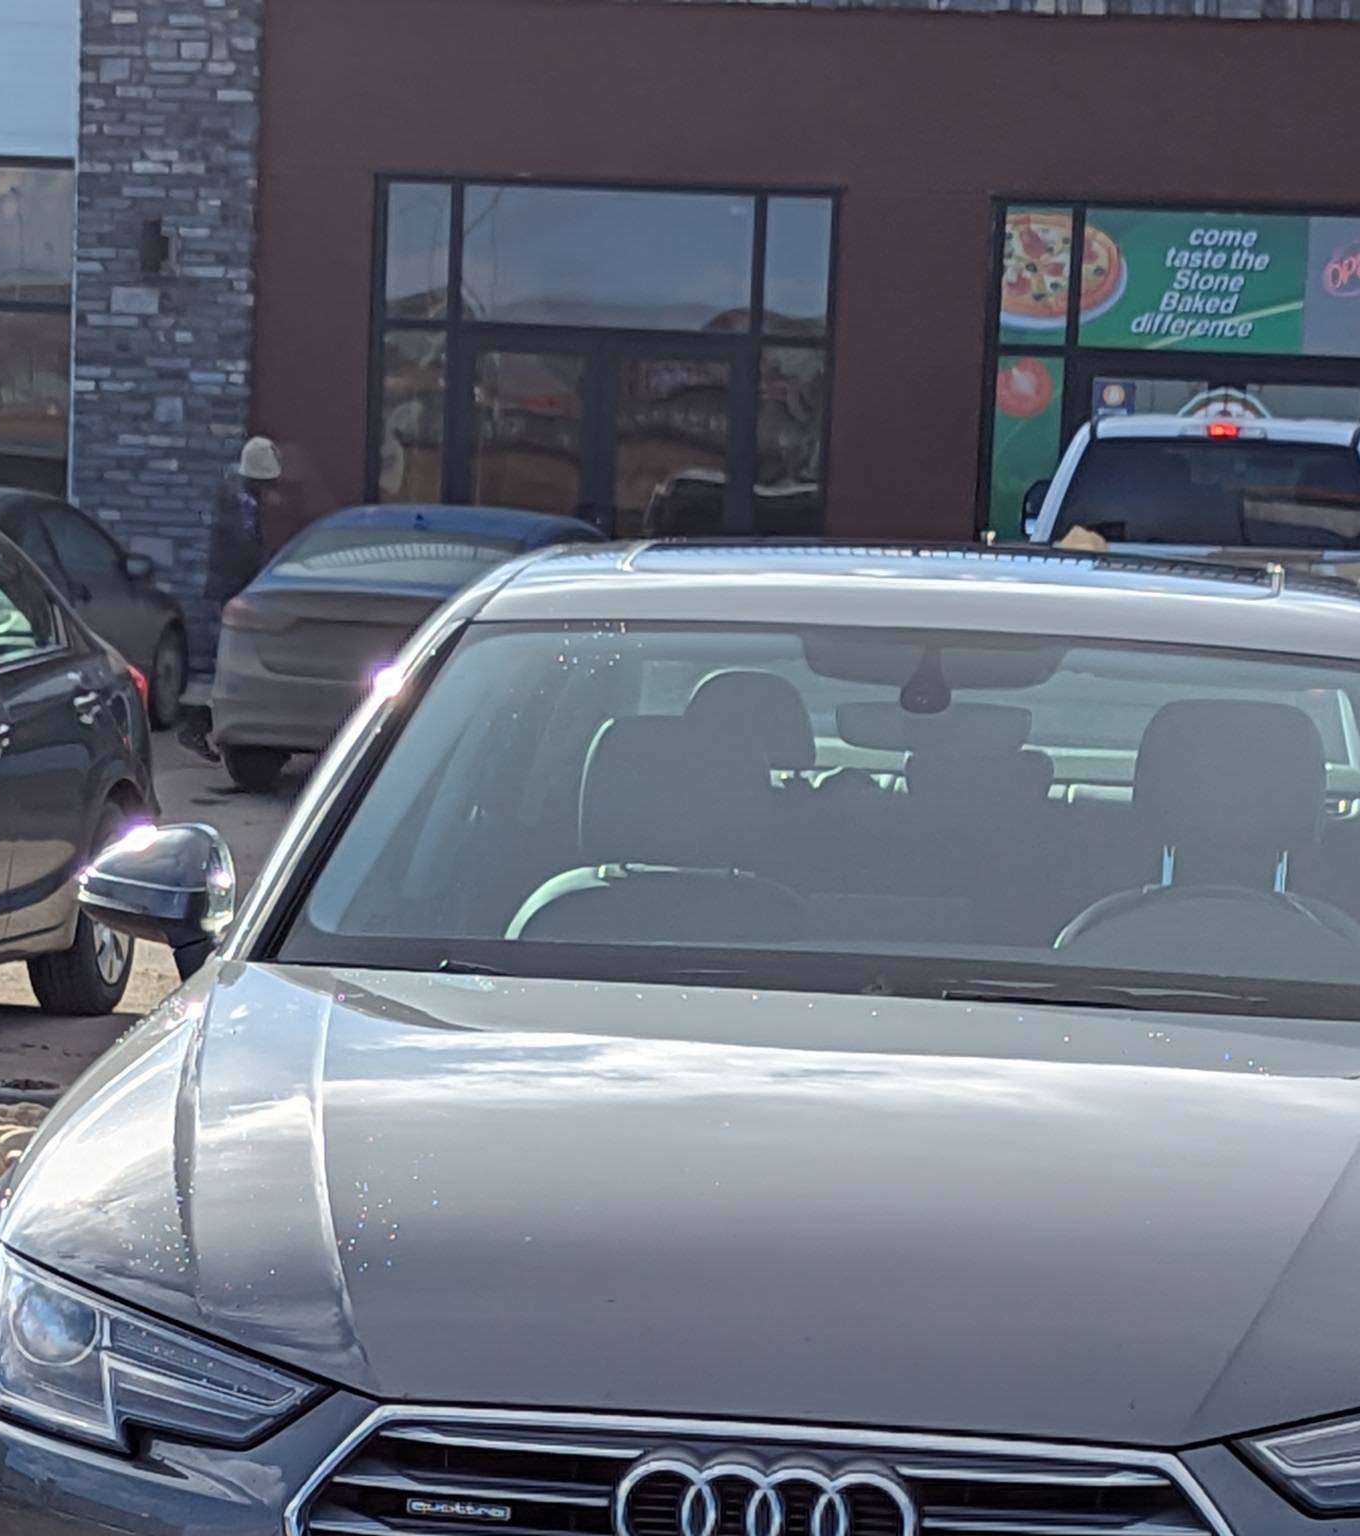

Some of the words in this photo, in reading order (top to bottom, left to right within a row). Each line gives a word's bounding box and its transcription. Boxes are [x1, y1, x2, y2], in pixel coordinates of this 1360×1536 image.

[1189, 228, 1258, 248] come
[1165, 248, 1226, 269] taste
[1230, 250, 1270, 271] the
[1172, 269, 1245, 291] Stone
[1159, 291, 1239, 314] Baked
[1130, 313, 1252, 338] difference
